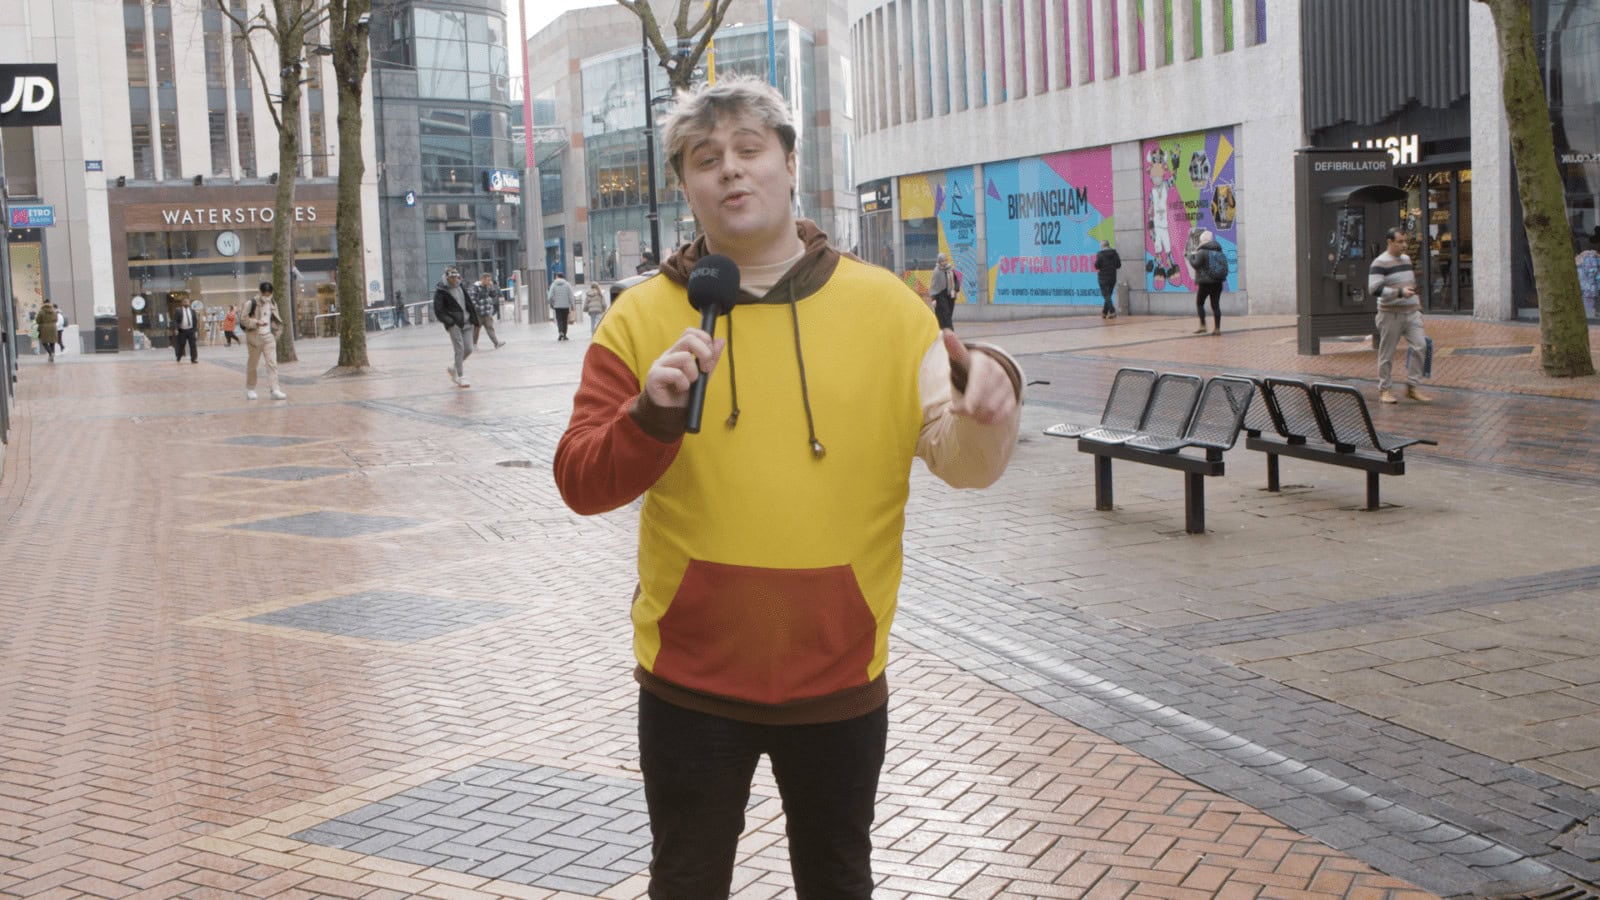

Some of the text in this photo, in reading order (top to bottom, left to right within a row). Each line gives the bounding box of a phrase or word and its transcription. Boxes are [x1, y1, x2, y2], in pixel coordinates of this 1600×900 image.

[1, 76, 54, 113] JD
[1314, 161, 1386, 171] DEFIBRILLATOR
[1007, 186, 1089, 220] BIRMINGHAM
[162, 206, 317, 225] WATERSTOES
[1034, 221, 1062, 246] 2022
[1000, 254, 1099, 275] OFFICIAL STORE
